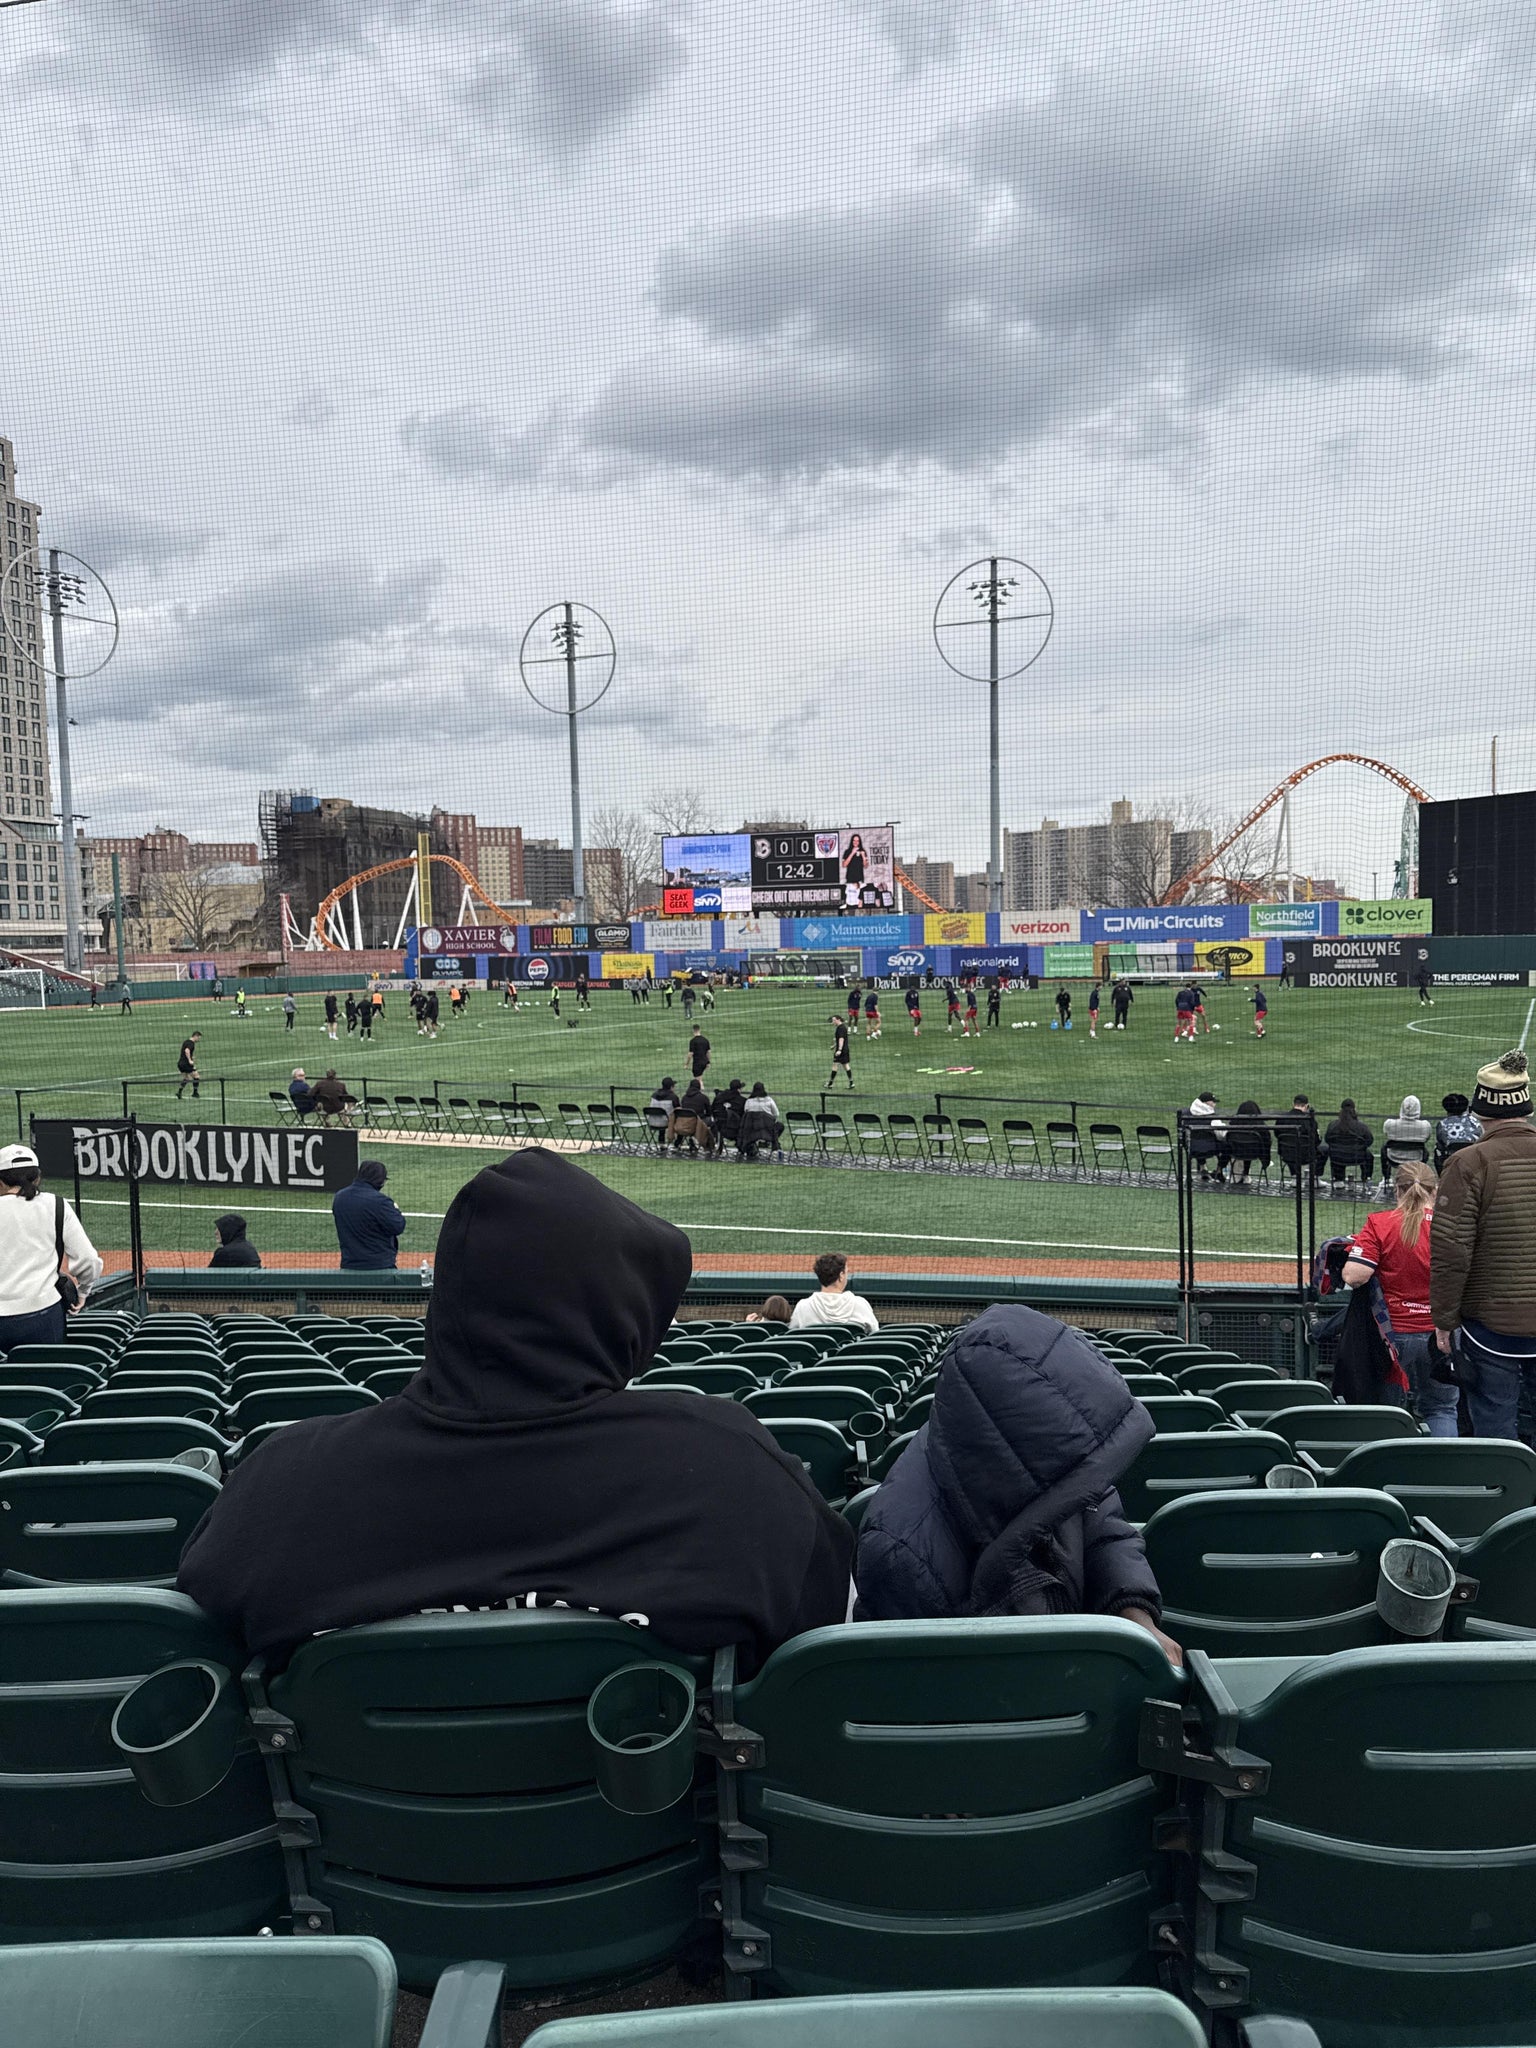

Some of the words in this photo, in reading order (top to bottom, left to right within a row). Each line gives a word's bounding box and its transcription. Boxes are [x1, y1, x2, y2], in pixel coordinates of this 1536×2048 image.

[780, 841, 788, 854] 0
[801, 840, 809, 853] 0
[777, 864, 814, 878] 12:42
[694, 896, 719, 906] SNY
[1256, 909, 1315, 921] Northfield
[1366, 906, 1423, 921] clover
[831, 922, 901, 935] Maimonides
[1011, 920, 1070, 934] verizon
[1126, 914, 1224, 930] Mini-Circuits
[444, 929, 496, 941] XAVIER
[533, 928, 552, 945] FILM
[553, 927, 572, 944] FOOD
[573, 927, 588, 943] FUN
[651, 923, 703, 937] Fairfield
[1313, 941, 1386, 957] BROOKLYN
[1388, 941, 1401, 954] FC
[887, 953, 922, 966] SNY
[873, 976, 900, 989] David
[1309, 973, 1383, 987] BROOKLYN
[1384, 973, 1397, 984] FC
[1432, 973, 1449, 981] THE
[72, 1126, 280, 1185] BROOKLYN
[286, 1133, 325, 1180] FC
